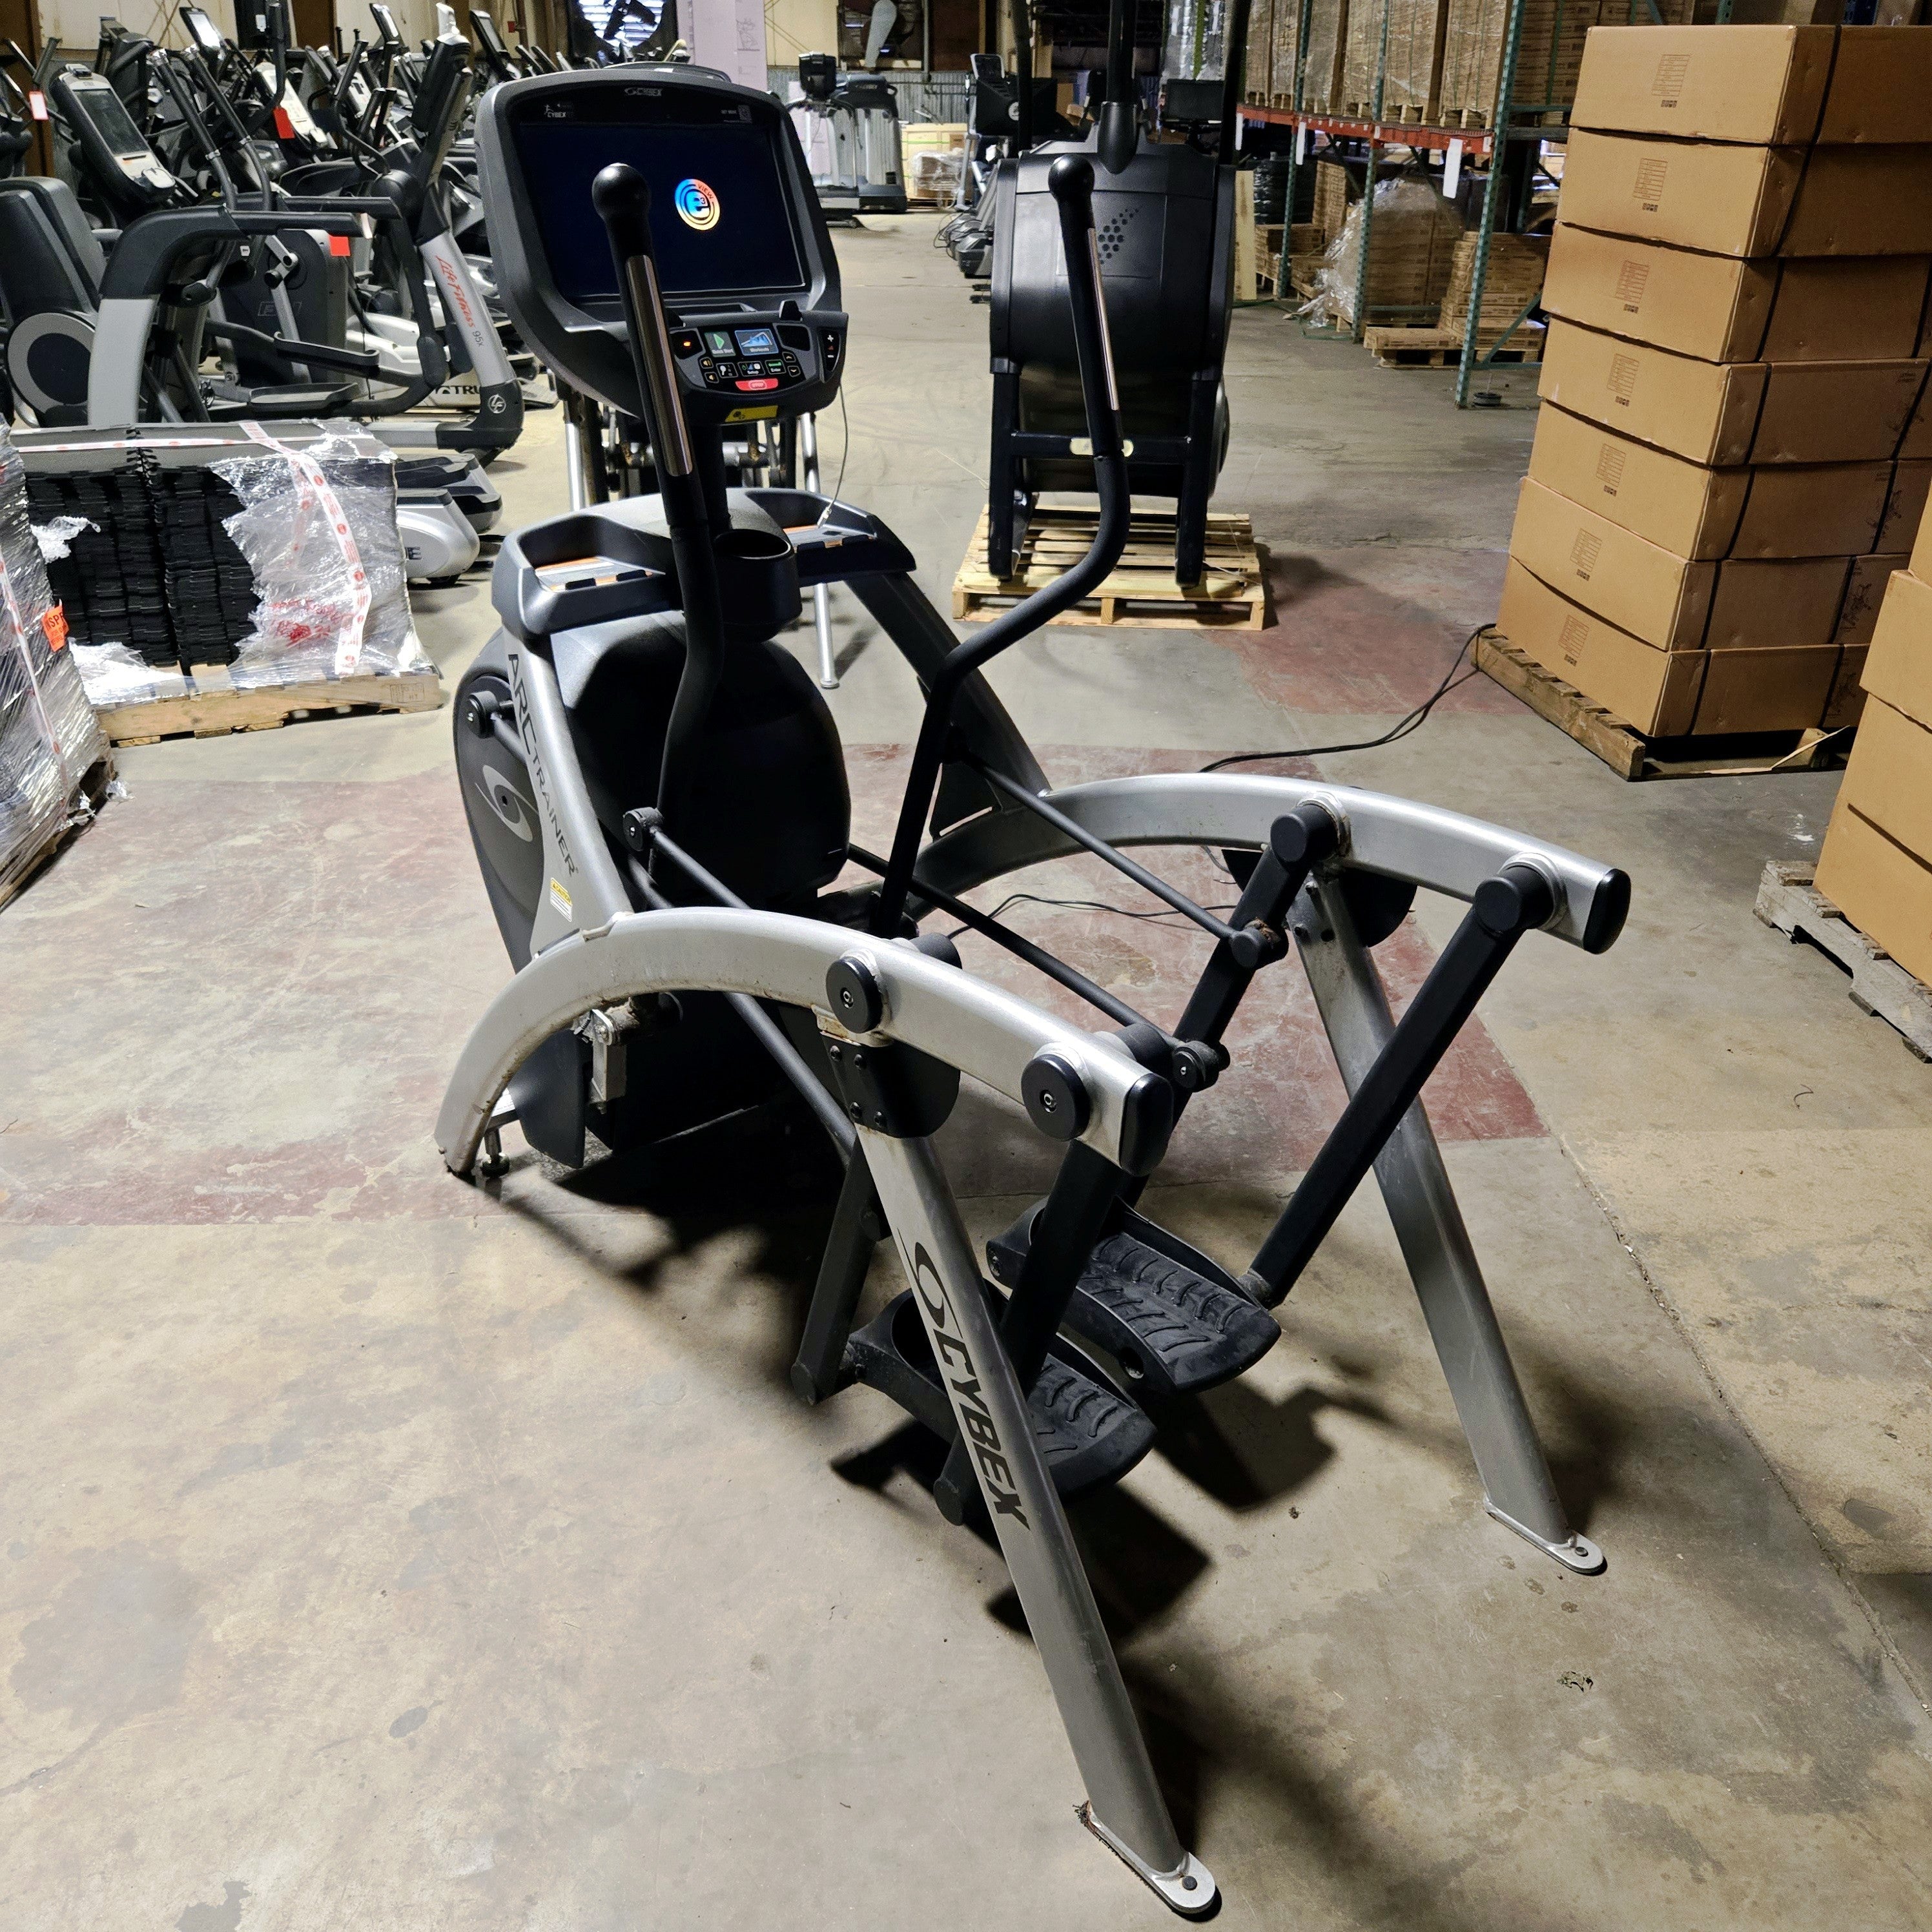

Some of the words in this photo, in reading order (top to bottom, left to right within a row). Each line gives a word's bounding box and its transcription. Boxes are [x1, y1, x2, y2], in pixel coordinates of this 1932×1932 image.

[698, 184, 714, 200] VIEW
[436, 255, 457, 287] Life
[454, 285, 477, 328] Fitness
[933, 1328, 1031, 1532] CYBEX
